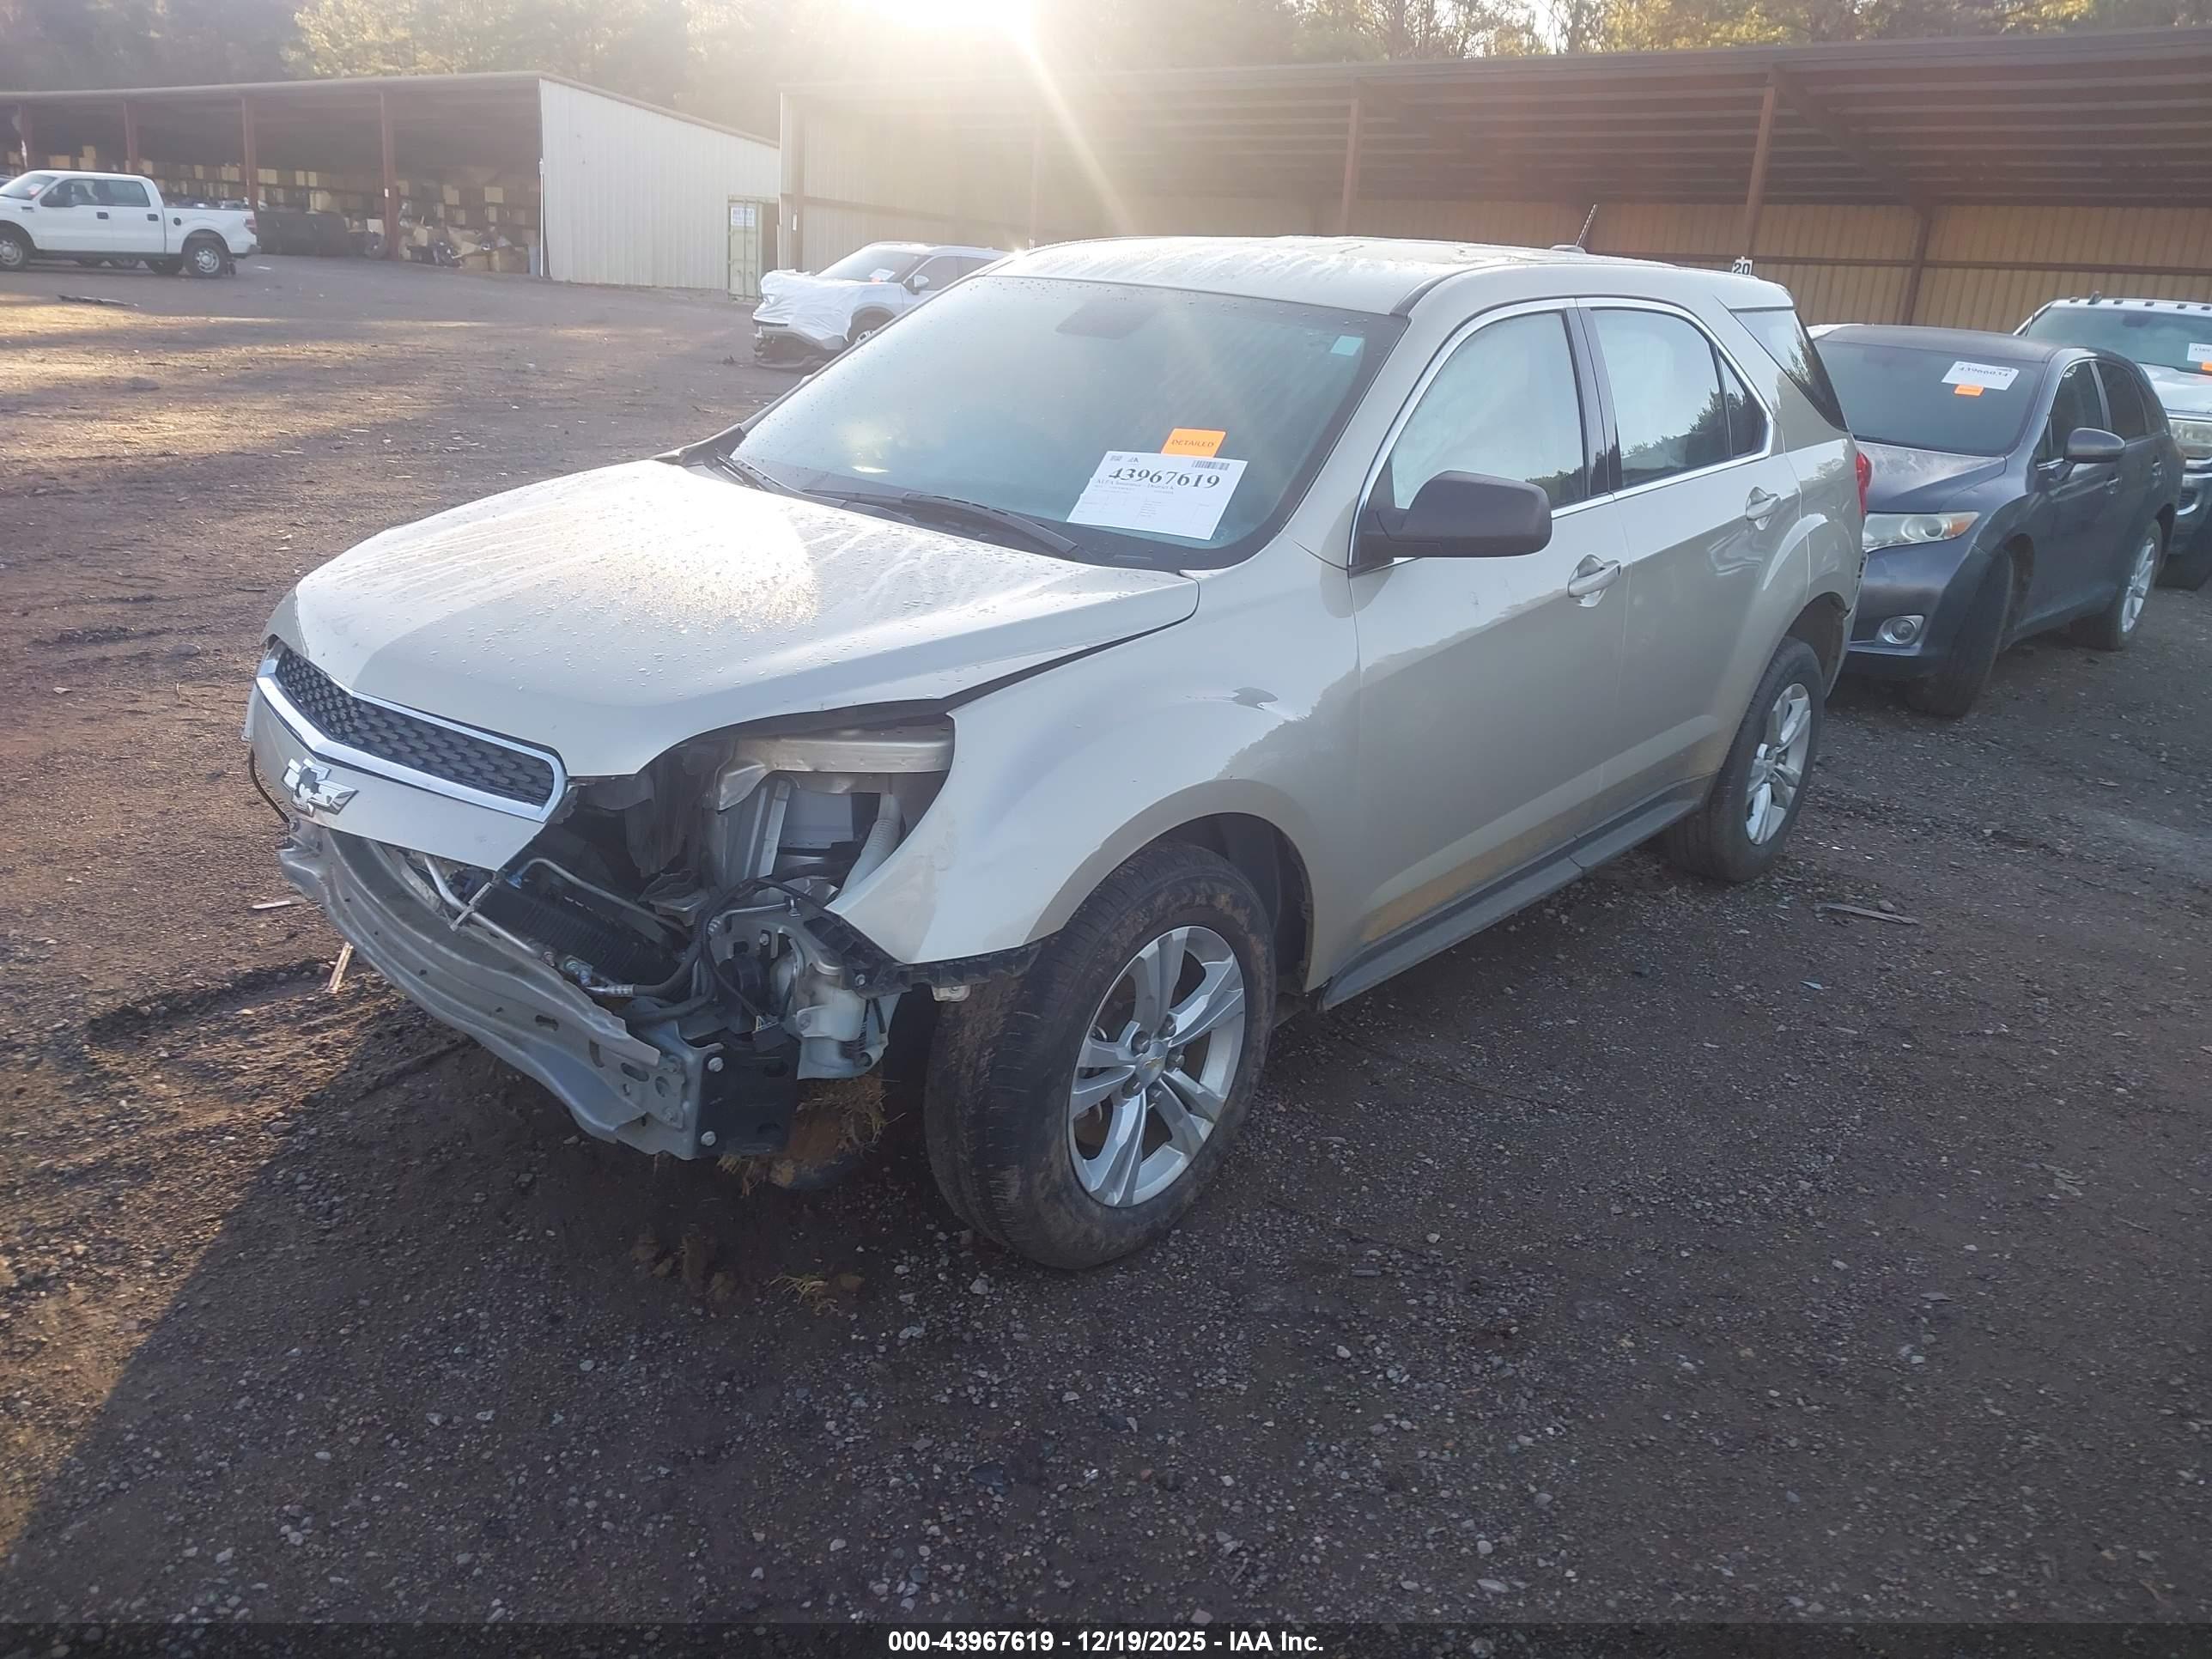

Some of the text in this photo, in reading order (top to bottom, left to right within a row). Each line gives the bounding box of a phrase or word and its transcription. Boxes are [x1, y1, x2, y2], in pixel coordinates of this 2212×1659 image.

[1733, 262, 1751, 275] 20
[1170, 439, 1215, 447] DETAILED
[1109, 467, 1220, 489] 43967619
